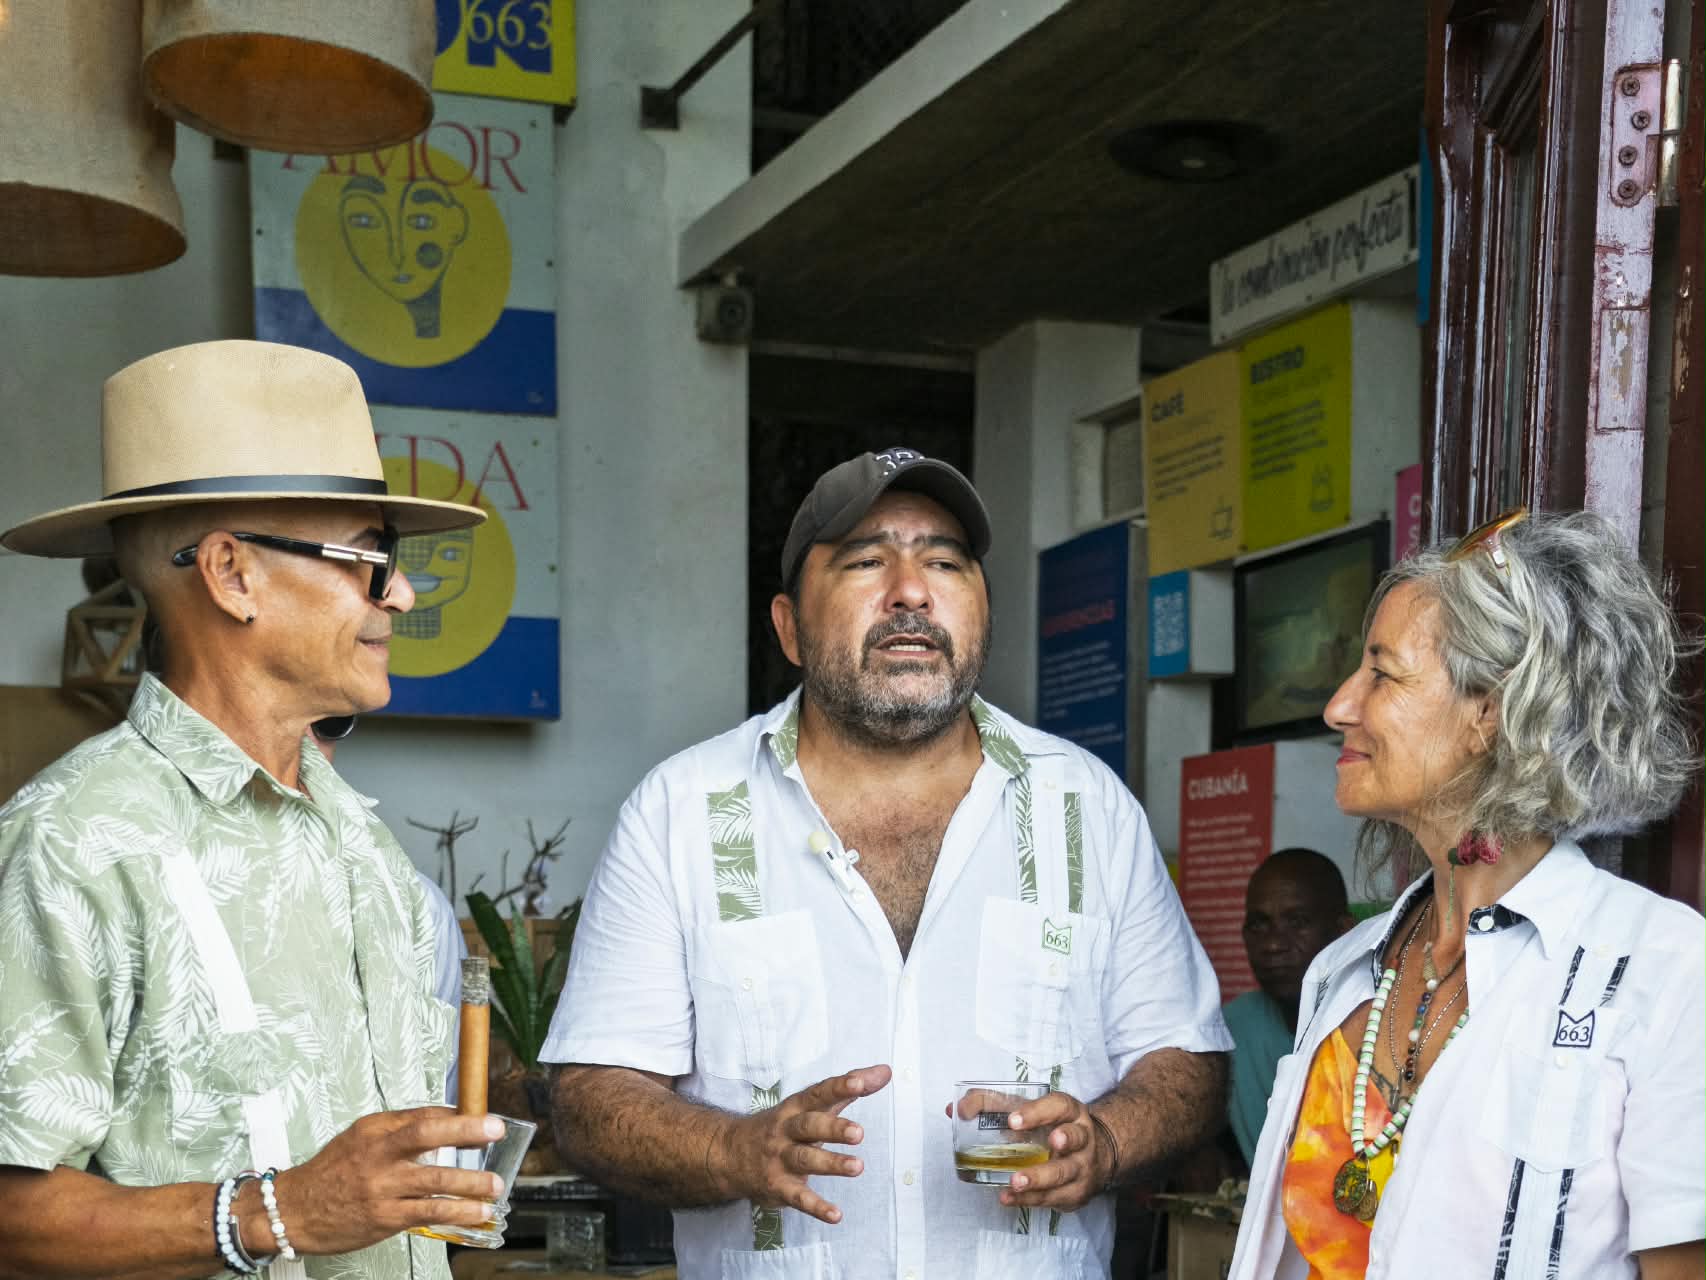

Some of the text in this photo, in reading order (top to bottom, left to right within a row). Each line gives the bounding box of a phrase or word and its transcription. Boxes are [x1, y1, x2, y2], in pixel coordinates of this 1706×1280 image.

[467, 0, 552, 48] 663
[281, 121, 527, 194] MOR
[1187, 767, 1249, 800] CUBANÍA
[1046, 931, 1069, 949] 663
[1558, 1024, 1590, 1042] 663
